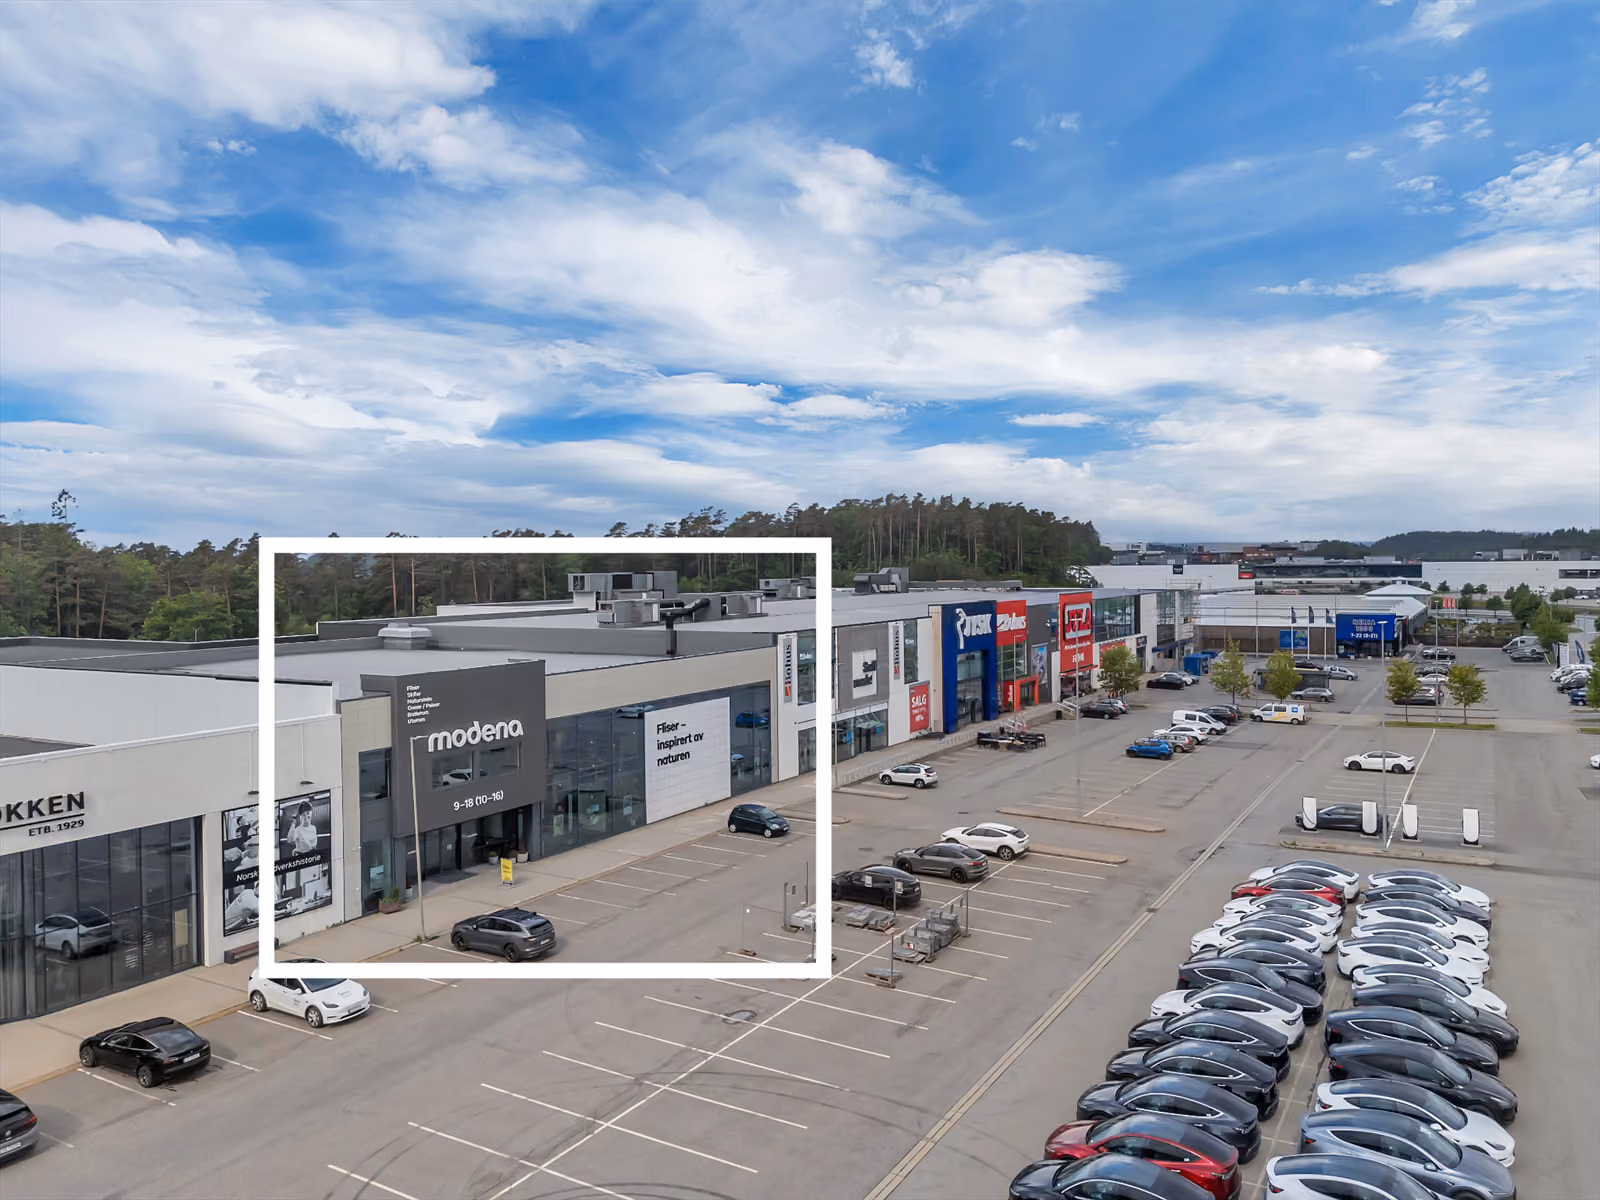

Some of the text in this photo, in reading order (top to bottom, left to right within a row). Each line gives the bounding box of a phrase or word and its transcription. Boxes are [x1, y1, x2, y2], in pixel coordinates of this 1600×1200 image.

[784, 644, 792, 686] Bohus
[911, 694, 927, 708] SALG
[428, 719, 524, 752] modena
[656, 722, 680, 735] Fliser
[656, 732, 704, 751] inspirert av
[657, 751, 690, 767] naturen
[0, 791, 85, 823] KKEN
[28, 819, 85, 837] ETB. 1929
[236, 870, 259, 882] Norsk
